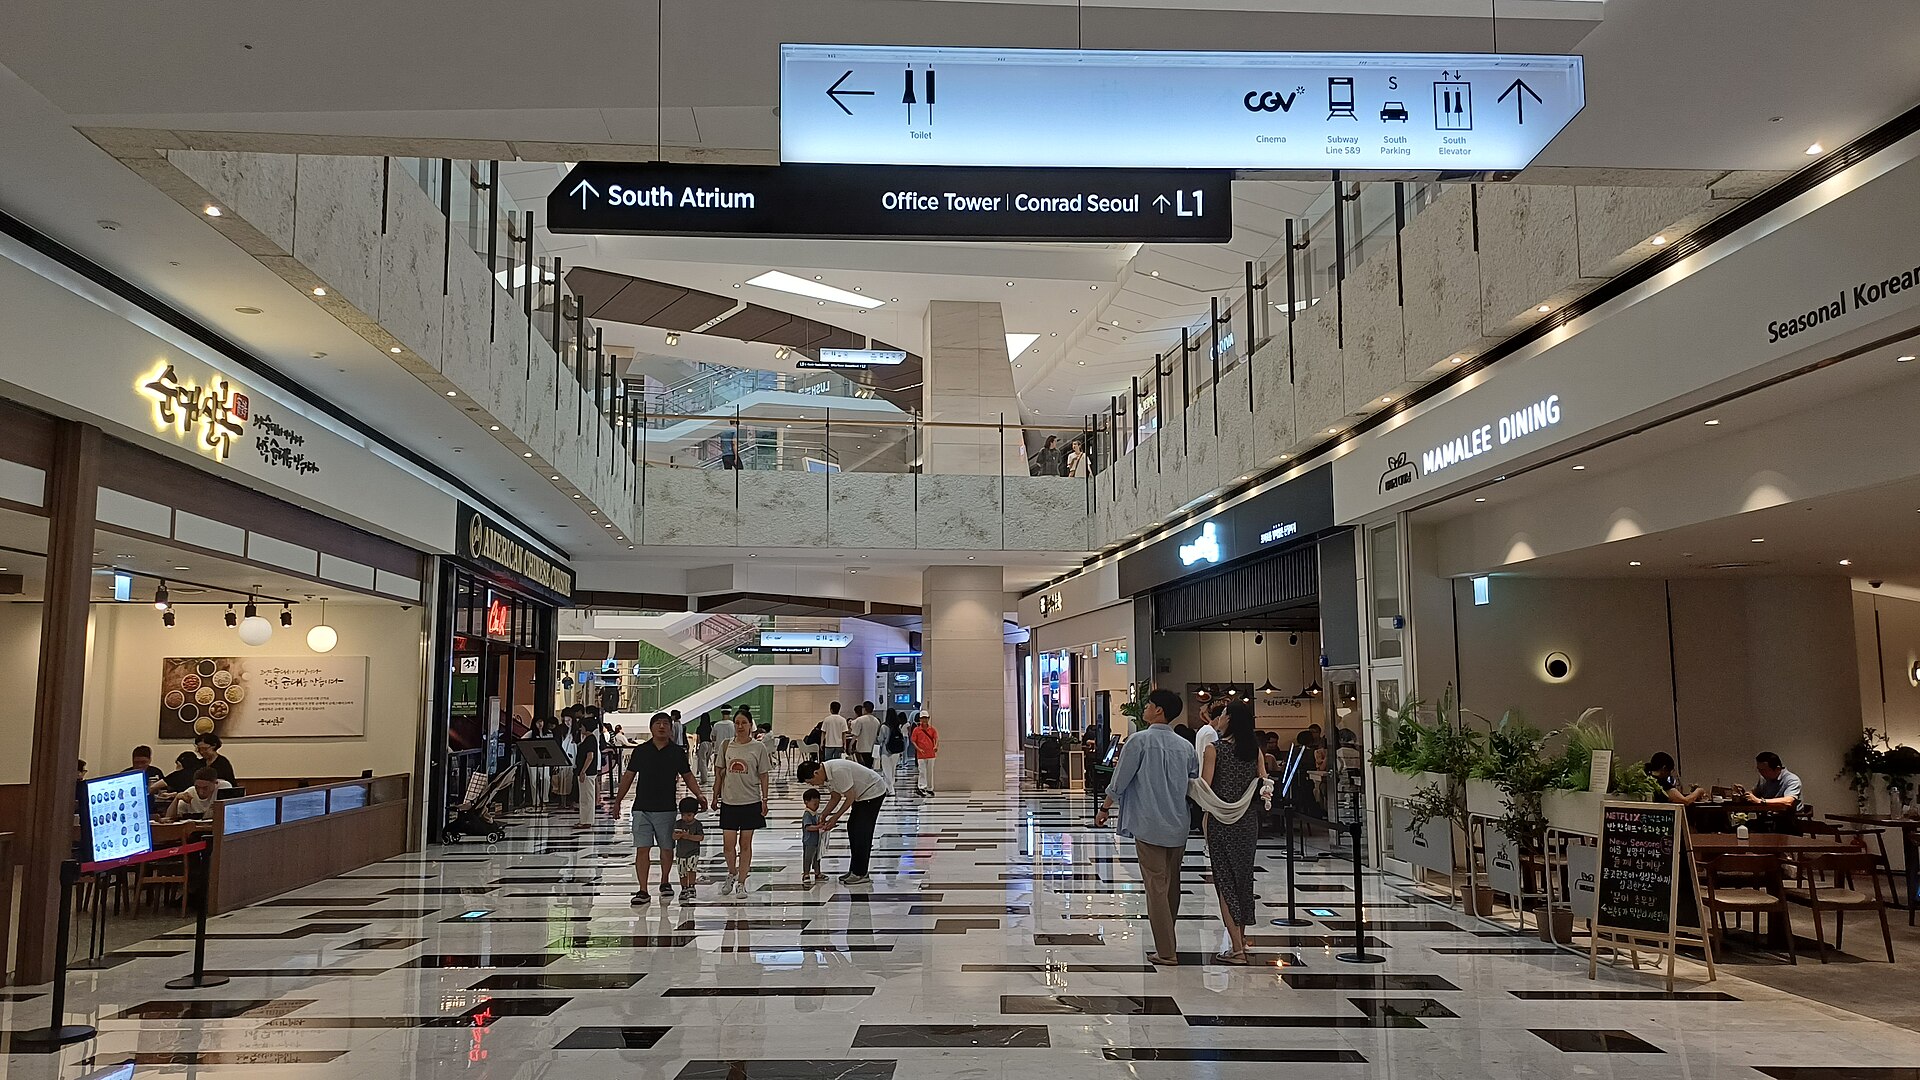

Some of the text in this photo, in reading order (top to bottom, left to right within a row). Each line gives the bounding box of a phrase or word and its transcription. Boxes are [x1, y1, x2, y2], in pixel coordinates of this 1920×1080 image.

[1388, 75, 1398, 90] S
[1244, 90, 1297, 113] CGV
[909, 130, 932, 141] Toilet
[1255, 134, 1287, 144] Cinema
[1326, 135, 1359, 146] Subway
[1382, 135, 1408, 144] South
[1442, 136, 1467, 145] South
[1325, 146, 1343, 155] Line
[1380, 146, 1411, 156] Parking
[1438, 146, 1472, 156] Elevator
[607, 185, 755, 210] South Atrium
[881, 191, 1001, 212] Office Tower
[1014, 192, 1139, 213] Conrad Seoul
[1176, 189, 1204, 217] L1
[1767, 290, 1847, 344] Seasonal
[1422, 394, 1562, 477] MAMALEE DINING
[481, 526, 572, 597] AMERICAN CHINESE CUISINE
[1605, 812, 1641, 822] NETFLIX
[1608, 837, 1628, 846] New
